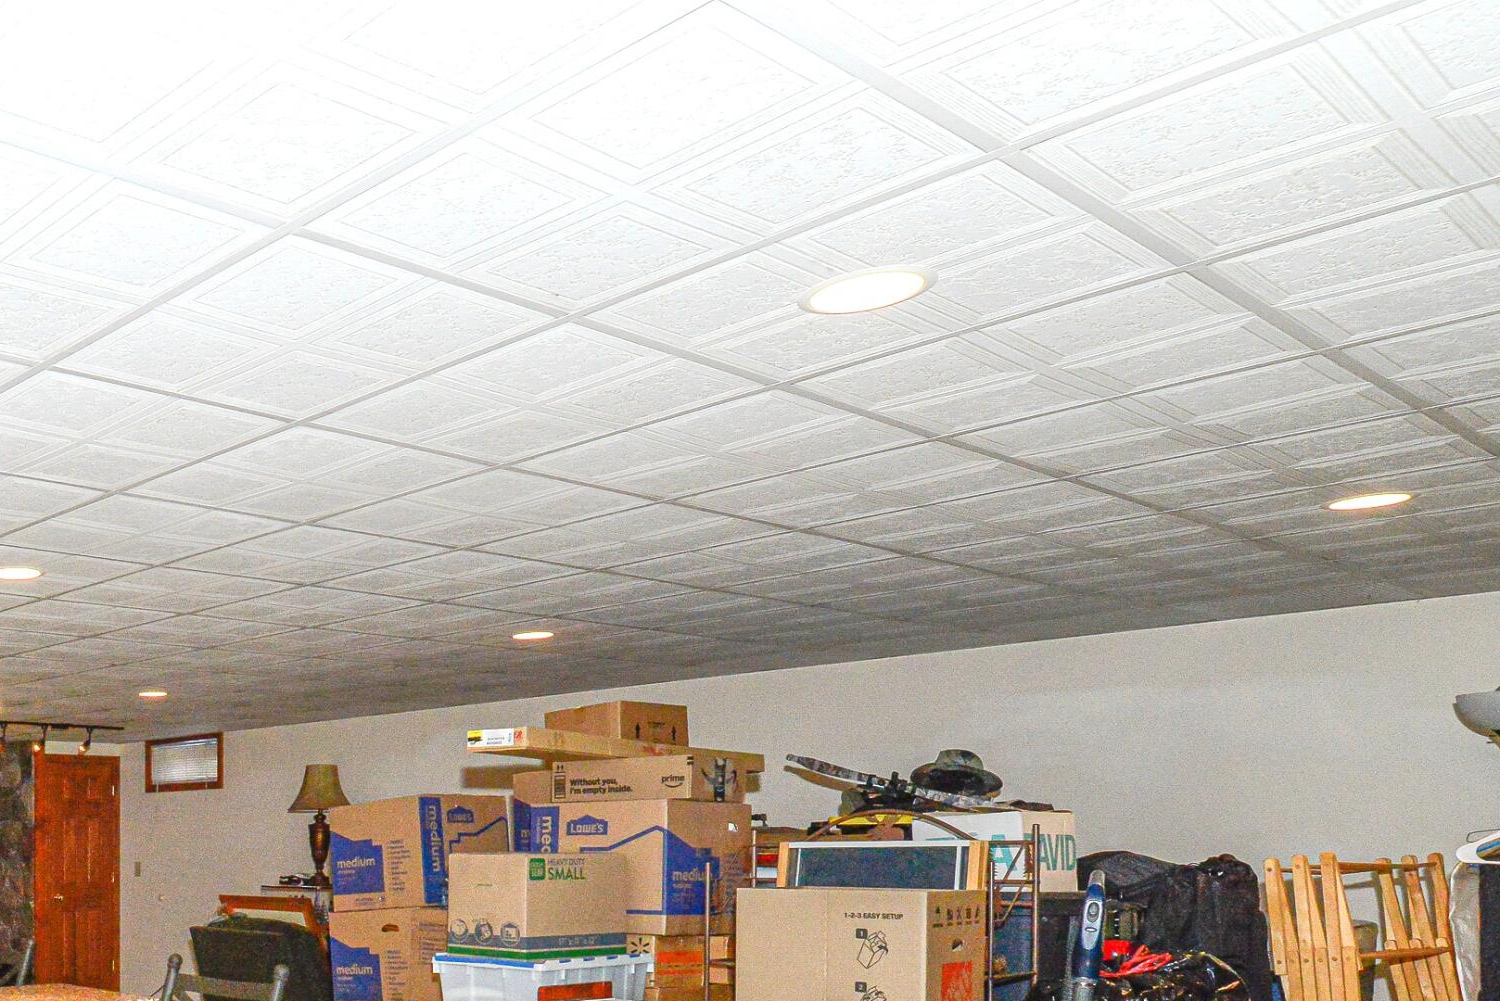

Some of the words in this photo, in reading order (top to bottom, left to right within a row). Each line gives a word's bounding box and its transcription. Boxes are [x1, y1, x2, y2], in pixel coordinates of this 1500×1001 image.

[570, 777, 600, 787] Without
[661, 774, 685, 784] prime
[582, 786, 606, 795] empty
[570, 823, 604, 834] LOWE'S
[429, 805, 440, 872] medium
[336, 856, 376, 869] medium
[547, 867, 587, 880] SMALL
[862, 912, 881, 920] EASY
[336, 963, 373, 975] medium
